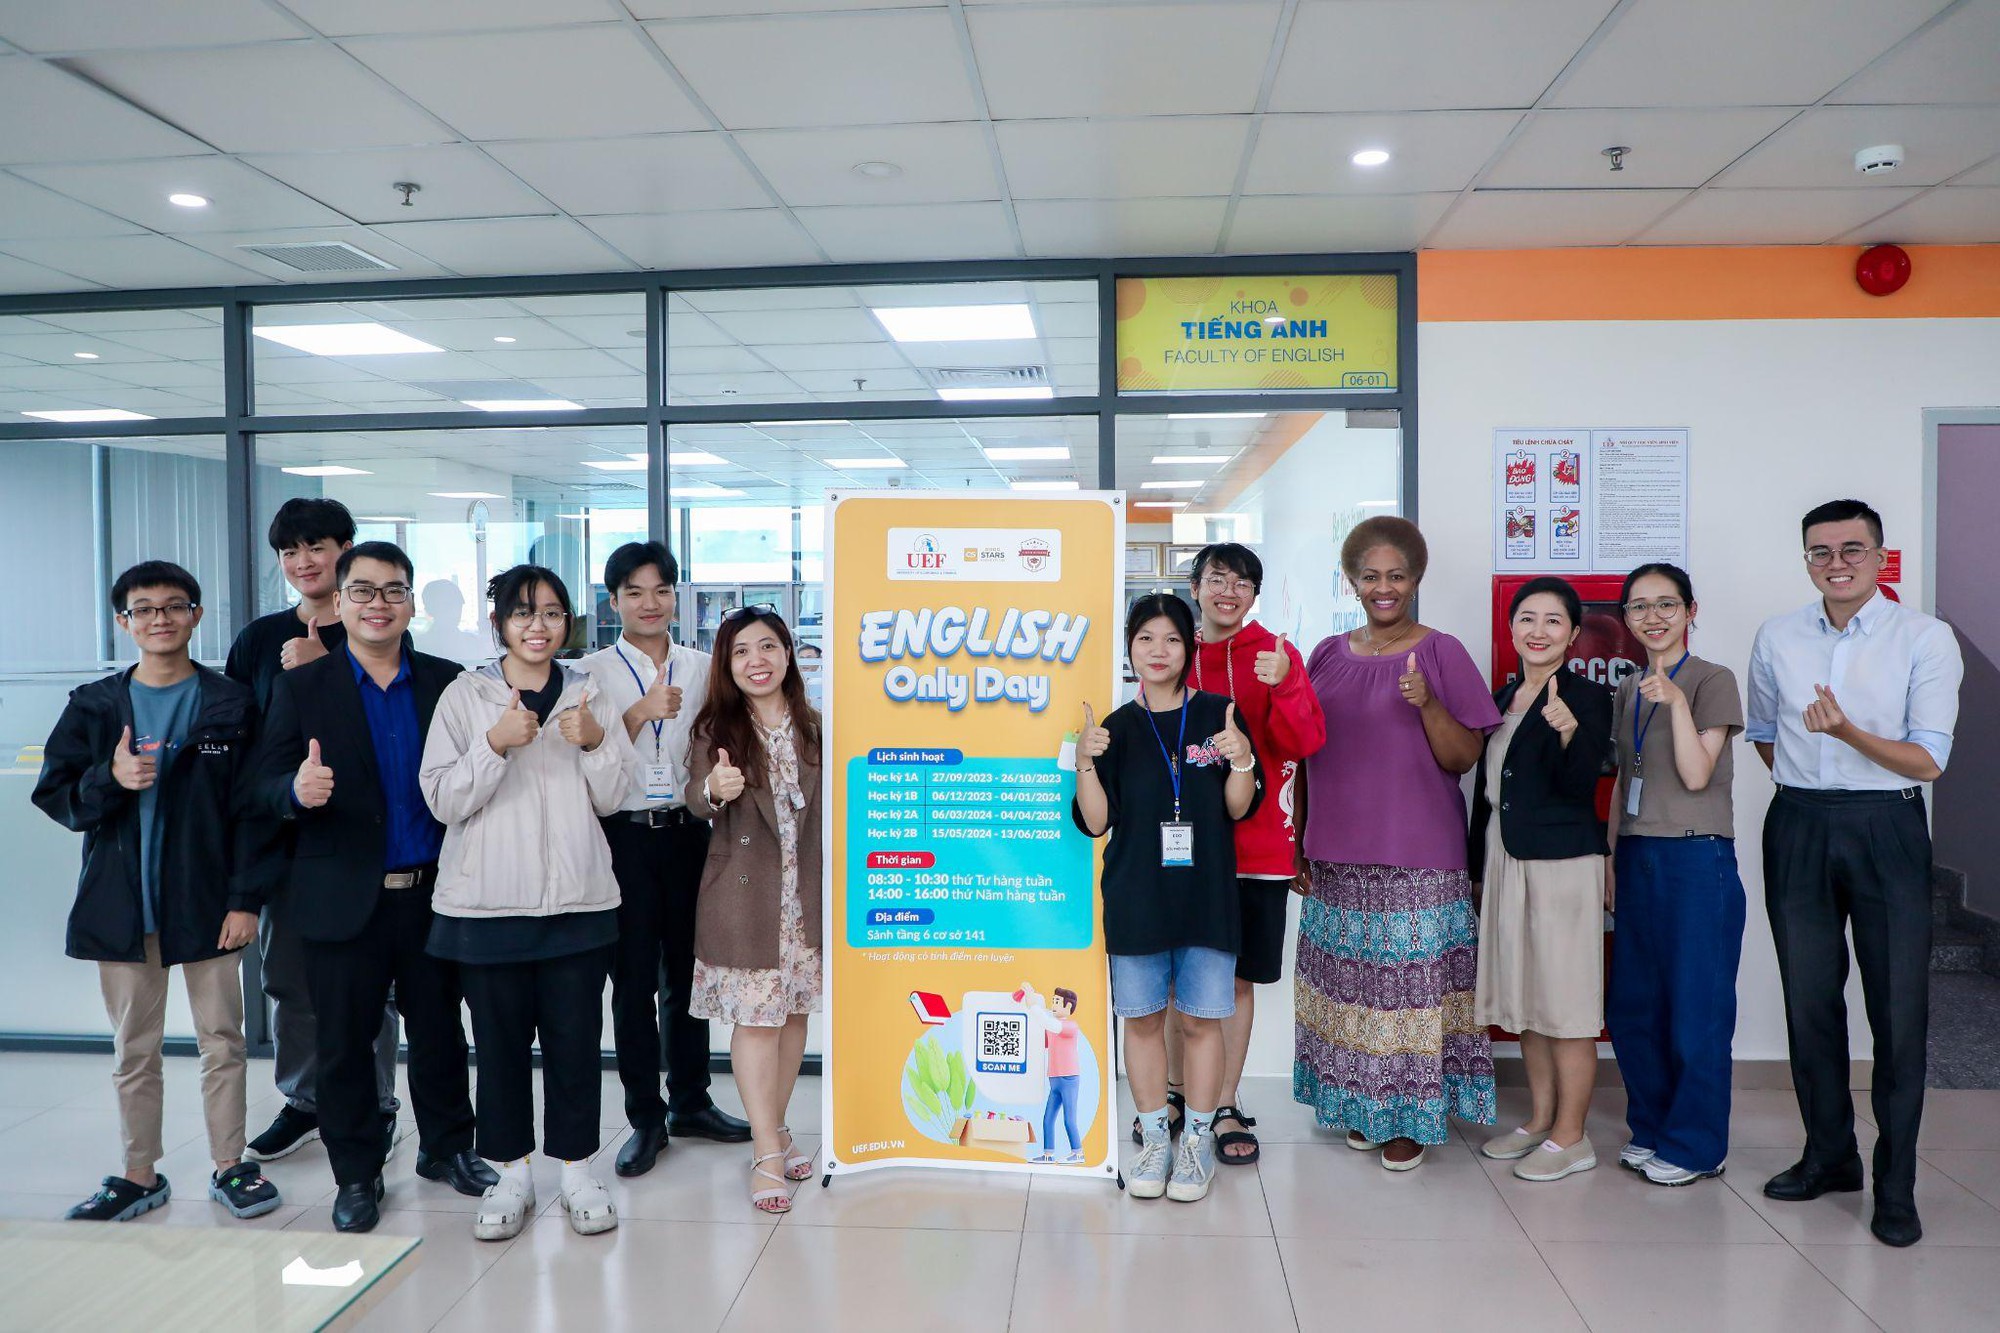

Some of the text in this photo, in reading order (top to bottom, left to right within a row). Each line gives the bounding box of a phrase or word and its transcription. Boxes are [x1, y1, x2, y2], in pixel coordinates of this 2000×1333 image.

[1231, 300, 1278, 314] KHOA
[1182, 315, 1327, 340] TIẾNG ANH
[1164, 348, 1345, 364] FACULTY OF ENGLISH
[1350, 375, 1380, 386] 06-01
[906, 553, 947, 568] UEF
[980, 551, 1005, 559] STARS
[858, 606, 1090, 664] ENGLISH
[884, 665, 1050, 712] Only Day
[877, 752, 945, 764] Lịch sinh hoạt
[868, 773, 888, 784] Học
[904, 773, 918, 782] 1A
[932, 773, 992, 782] 27/09/2023
[1001, 774, 1062, 782] 26/10/2023
[868, 792, 888, 802] Học
[904, 792, 918, 800] 1B
[932, 792, 992, 801] 06/12/2023
[1001, 792, 1062, 802] 04/01/2024
[868, 810, 888, 820] Học
[904, 810, 918, 819] 2A
[932, 810, 992, 820] 06/03/2024
[1001, 811, 1062, 820] 04/04/2024
[868, 829, 888, 838] Học
[904, 829, 918, 838] 2B
[932, 829, 992, 838] 15/05/2024
[1001, 830, 1062, 840] 13/06/2024
[876, 855, 922, 866] Thời gian
[868, 874, 903, 886] 08:30
[914, 874, 950, 886] 10:30
[952, 874, 974, 886] thứ
[976, 875, 992, 886] Tư
[994, 875, 1022, 888] hàng
[1026, 874, 1052, 887] tuần
[868, 888, 902, 900] 14:00
[914, 888, 949, 900] 16:00
[952, 888, 974, 900] thứ
[976, 890, 1002, 900] Năm
[1006, 889, 1036, 903] hàng
[1039, 889, 1066, 902] tuần
[875, 911, 920, 924] Địa điểm
[867, 929, 985, 942] Sảnh tầng 6 cơ sở 141
[982, 1062, 1020, 1072] SCAN ME
[852, 1140, 904, 1154] UEF.EDU.VN
